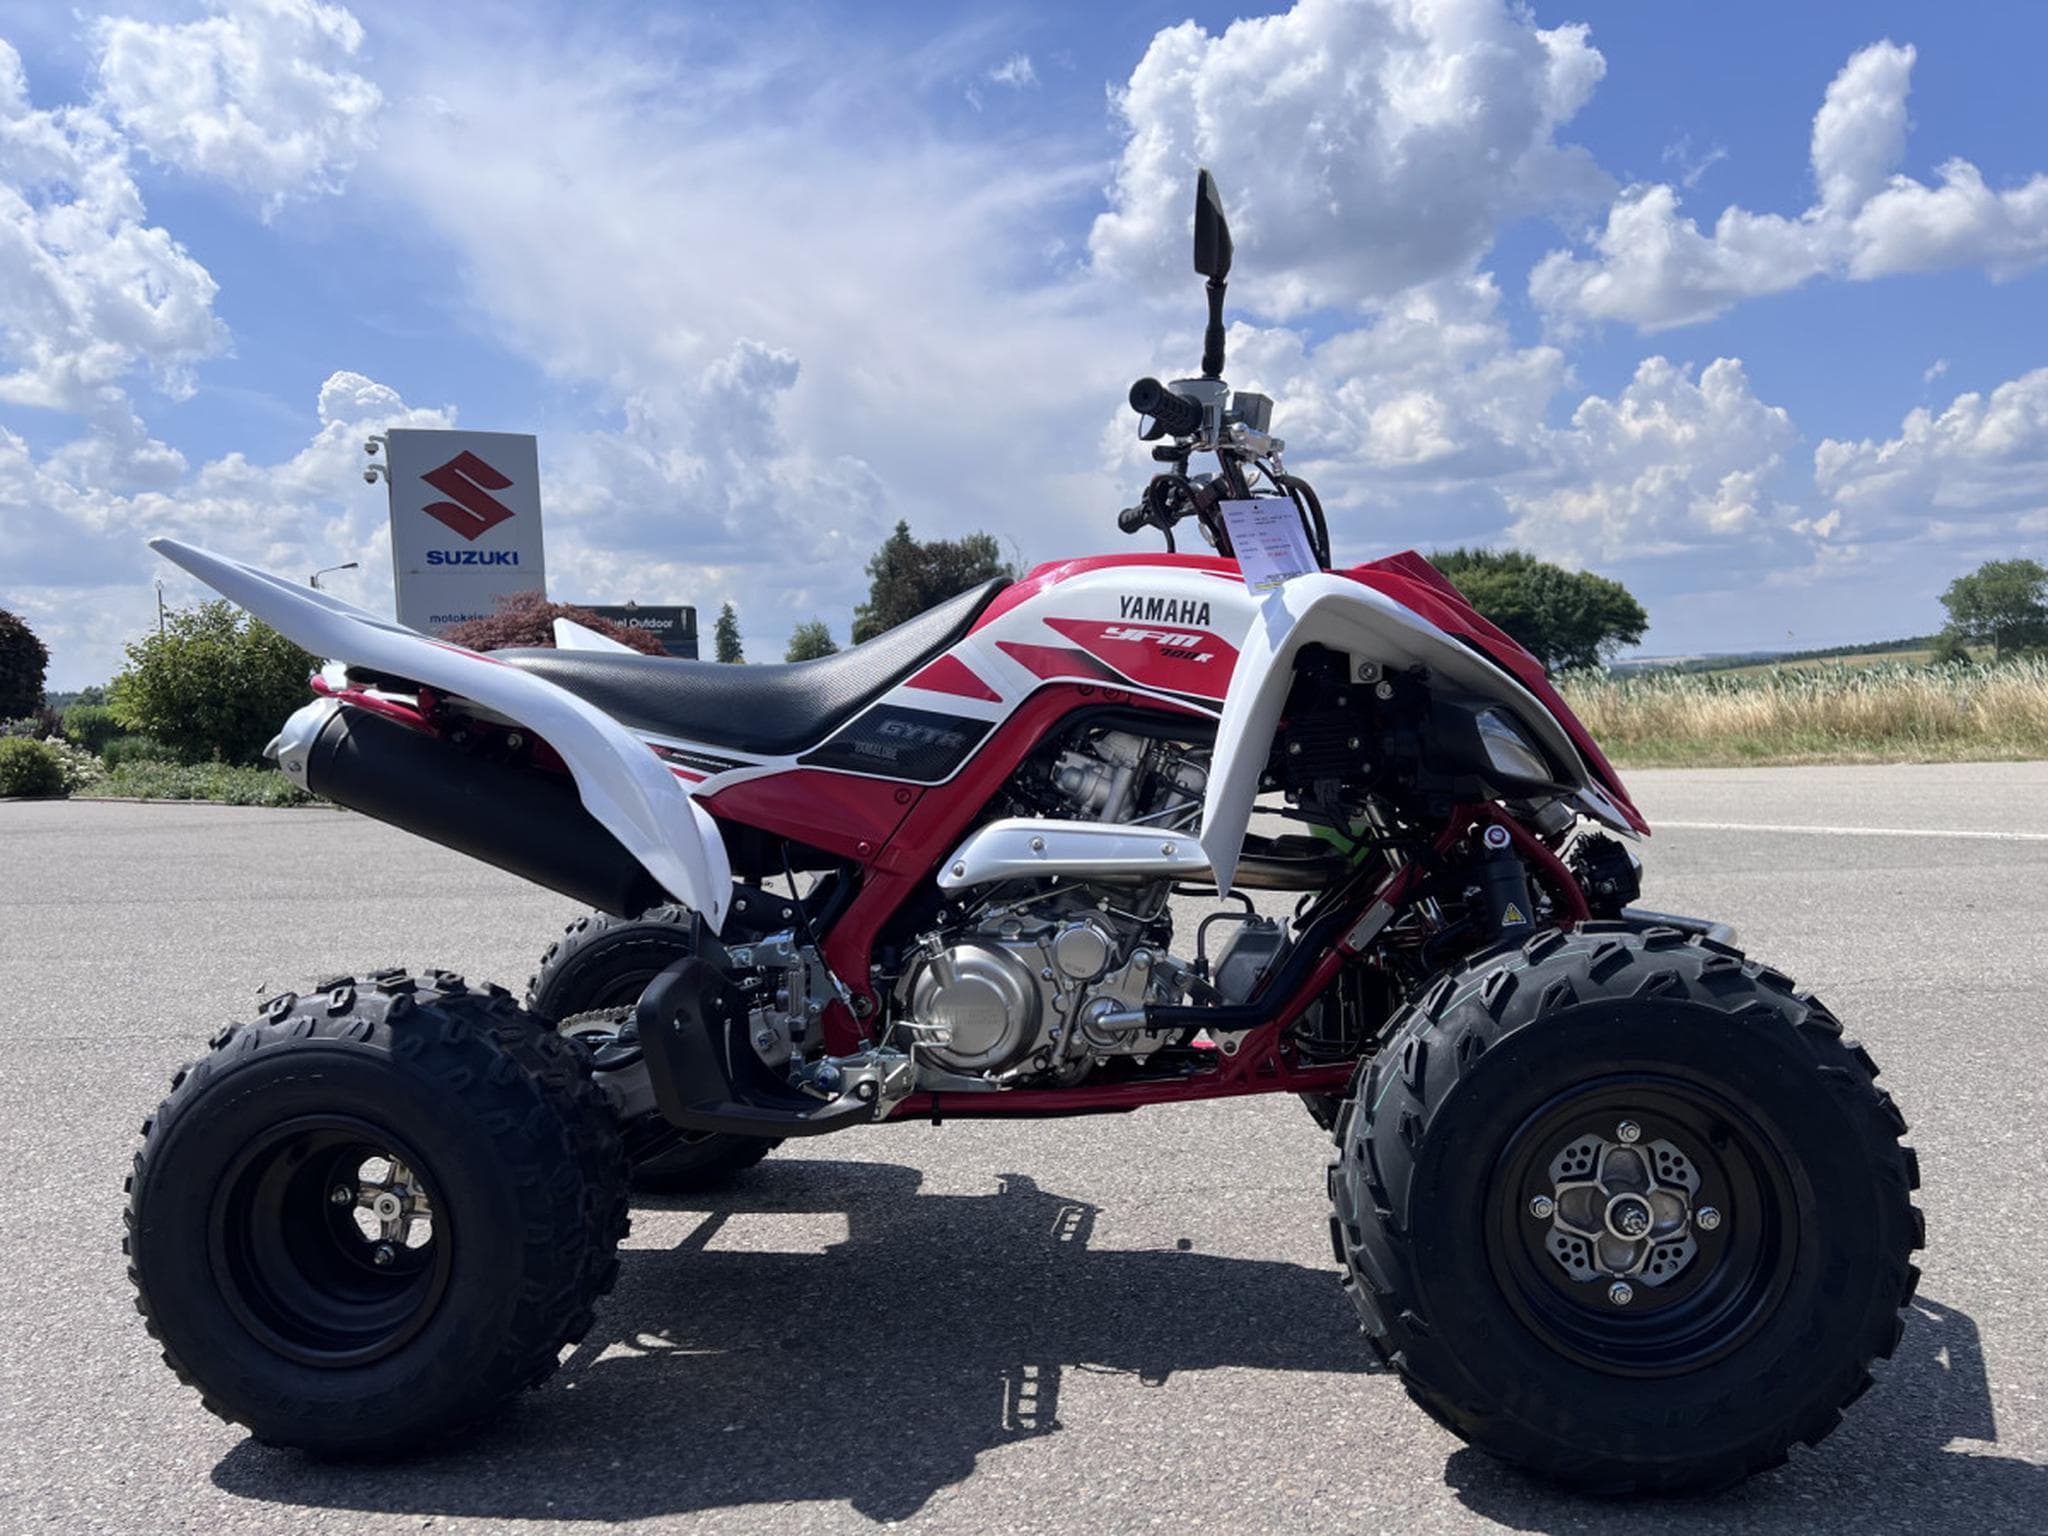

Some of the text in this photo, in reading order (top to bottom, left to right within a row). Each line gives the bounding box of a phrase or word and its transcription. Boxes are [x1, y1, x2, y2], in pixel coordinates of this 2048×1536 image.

[426, 550, 519, 565] SUZUKI
[1120, 595, 1210, 626] YAMAHA
[630, 618, 673, 629] Outdoor
[877, 720, 966, 747] GYTR
